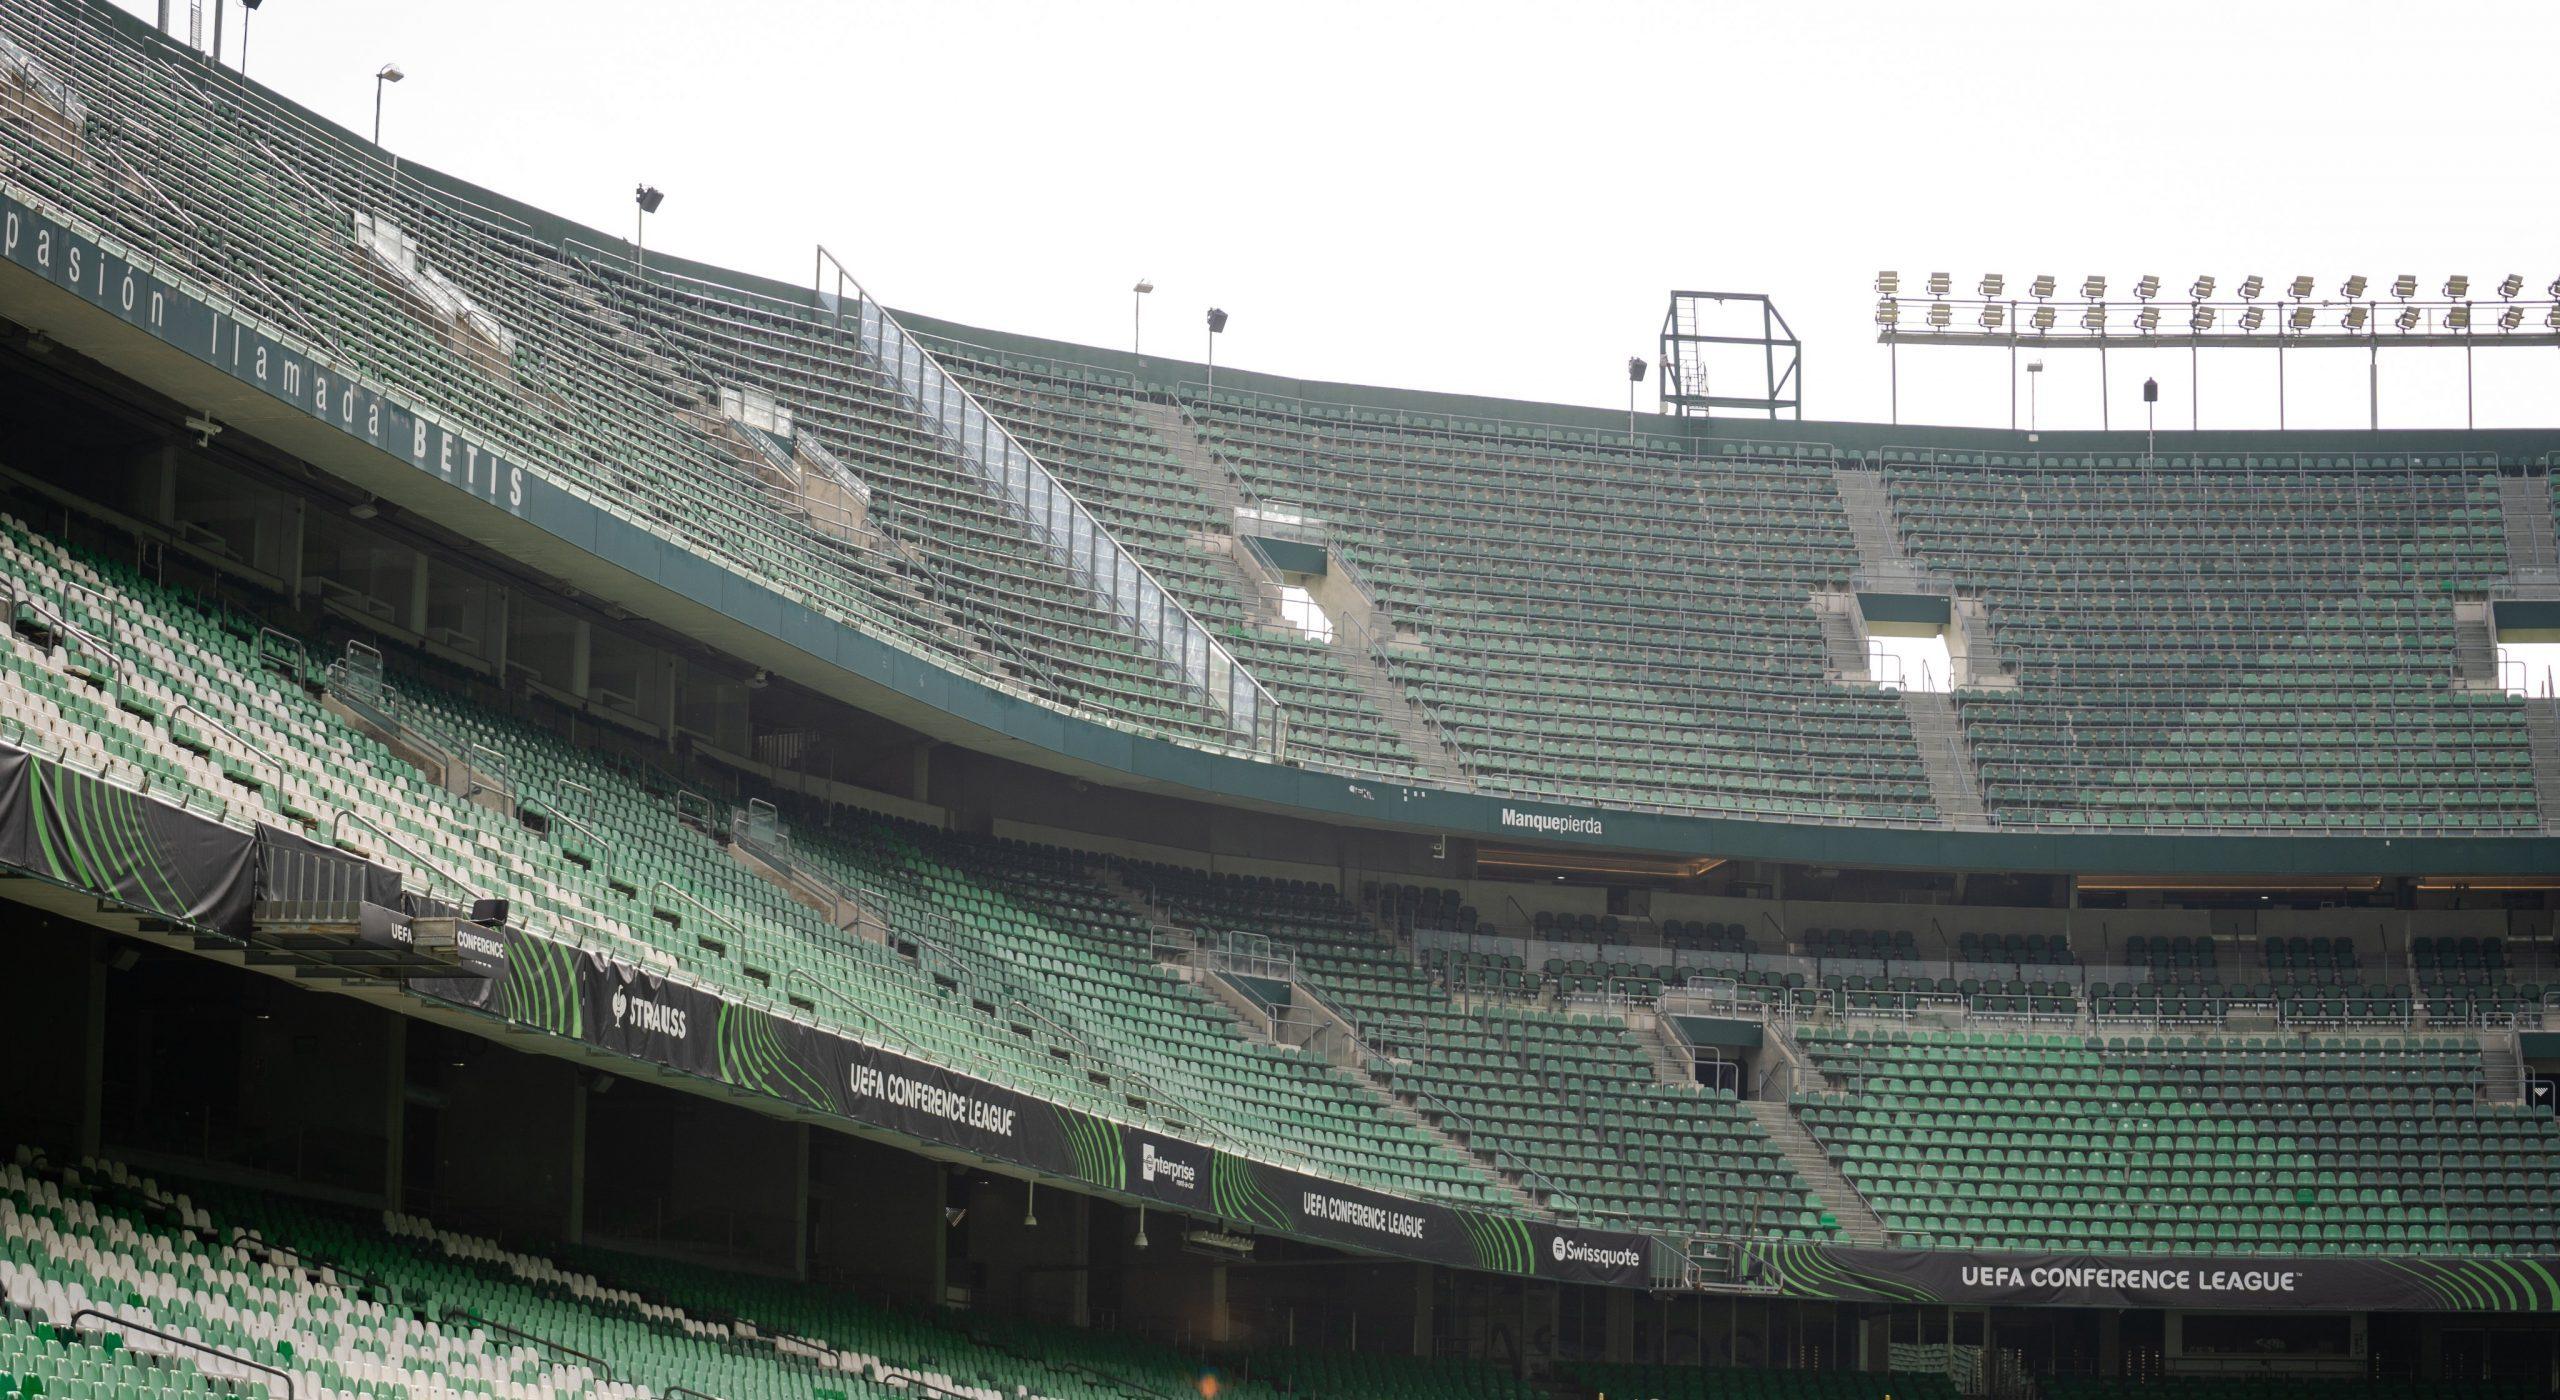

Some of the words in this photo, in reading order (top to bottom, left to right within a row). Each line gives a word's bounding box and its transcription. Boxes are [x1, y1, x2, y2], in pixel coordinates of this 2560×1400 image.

[5, 211, 164, 327] pasión
[212, 312, 379, 437] llamada
[413, 418, 522, 506] BETIS
[1502, 808, 1603, 835] Manquepierda
[391, 922, 413, 944] UEFA
[457, 930, 504, 959] CONFERENCE
[630, 995, 687, 1039] STRAUSS
[851, 1062, 885, 1100] UEFA
[887, 1073, 966, 1124] CONFERENCE
[1143, 1153, 1195, 1182] enterprise
[1303, 1191, 1328, 1219] UEFA
[1328, 1197, 1386, 1232] CONFERENCE
[1566, 1240, 1640, 1269] Swissquote
[1962, 1266, 2026, 1288] UEFA
[2030, 1267, 2190, 1291] CONFERENCE
